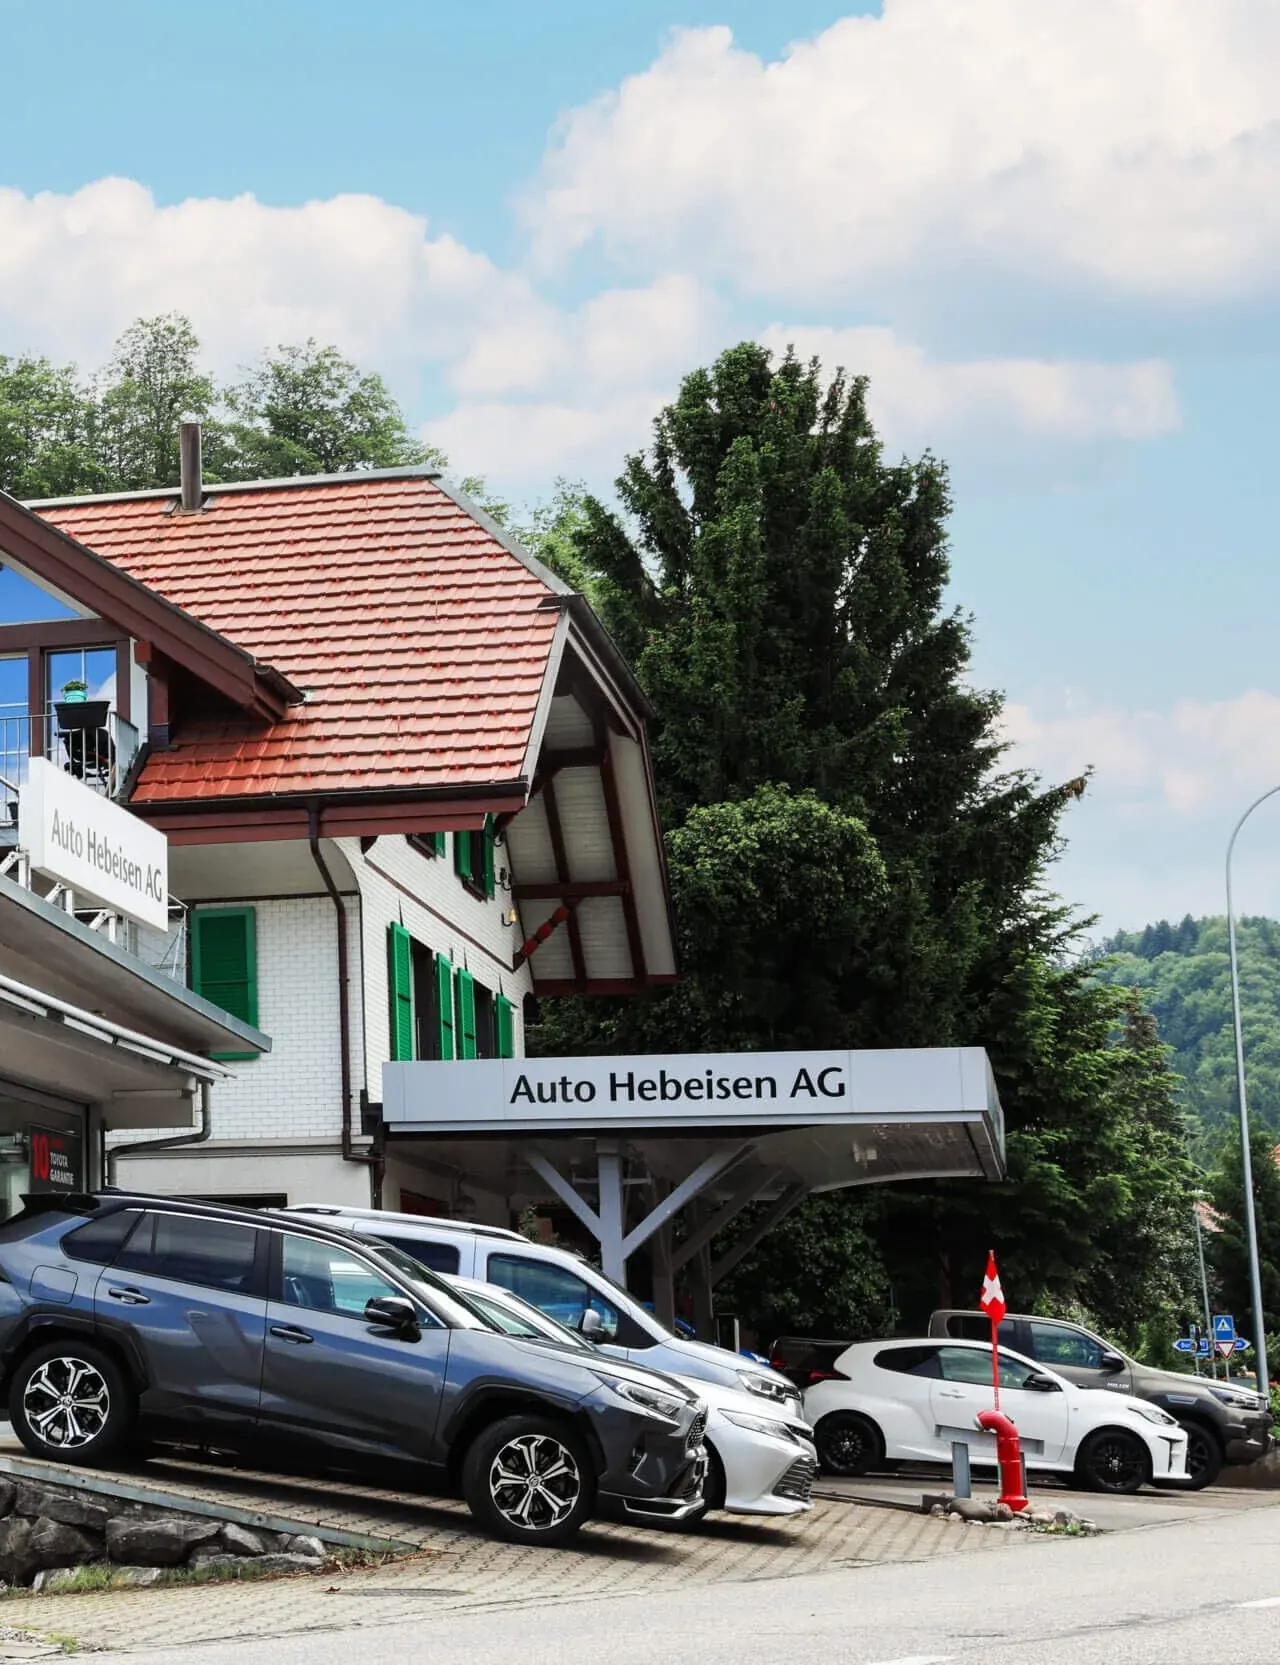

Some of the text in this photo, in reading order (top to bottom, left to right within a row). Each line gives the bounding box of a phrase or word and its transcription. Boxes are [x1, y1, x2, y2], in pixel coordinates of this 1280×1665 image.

[51, 808, 162, 903] Auto Hebeisen AG
[510, 1066, 846, 1104] Auto Hebeisen AG
